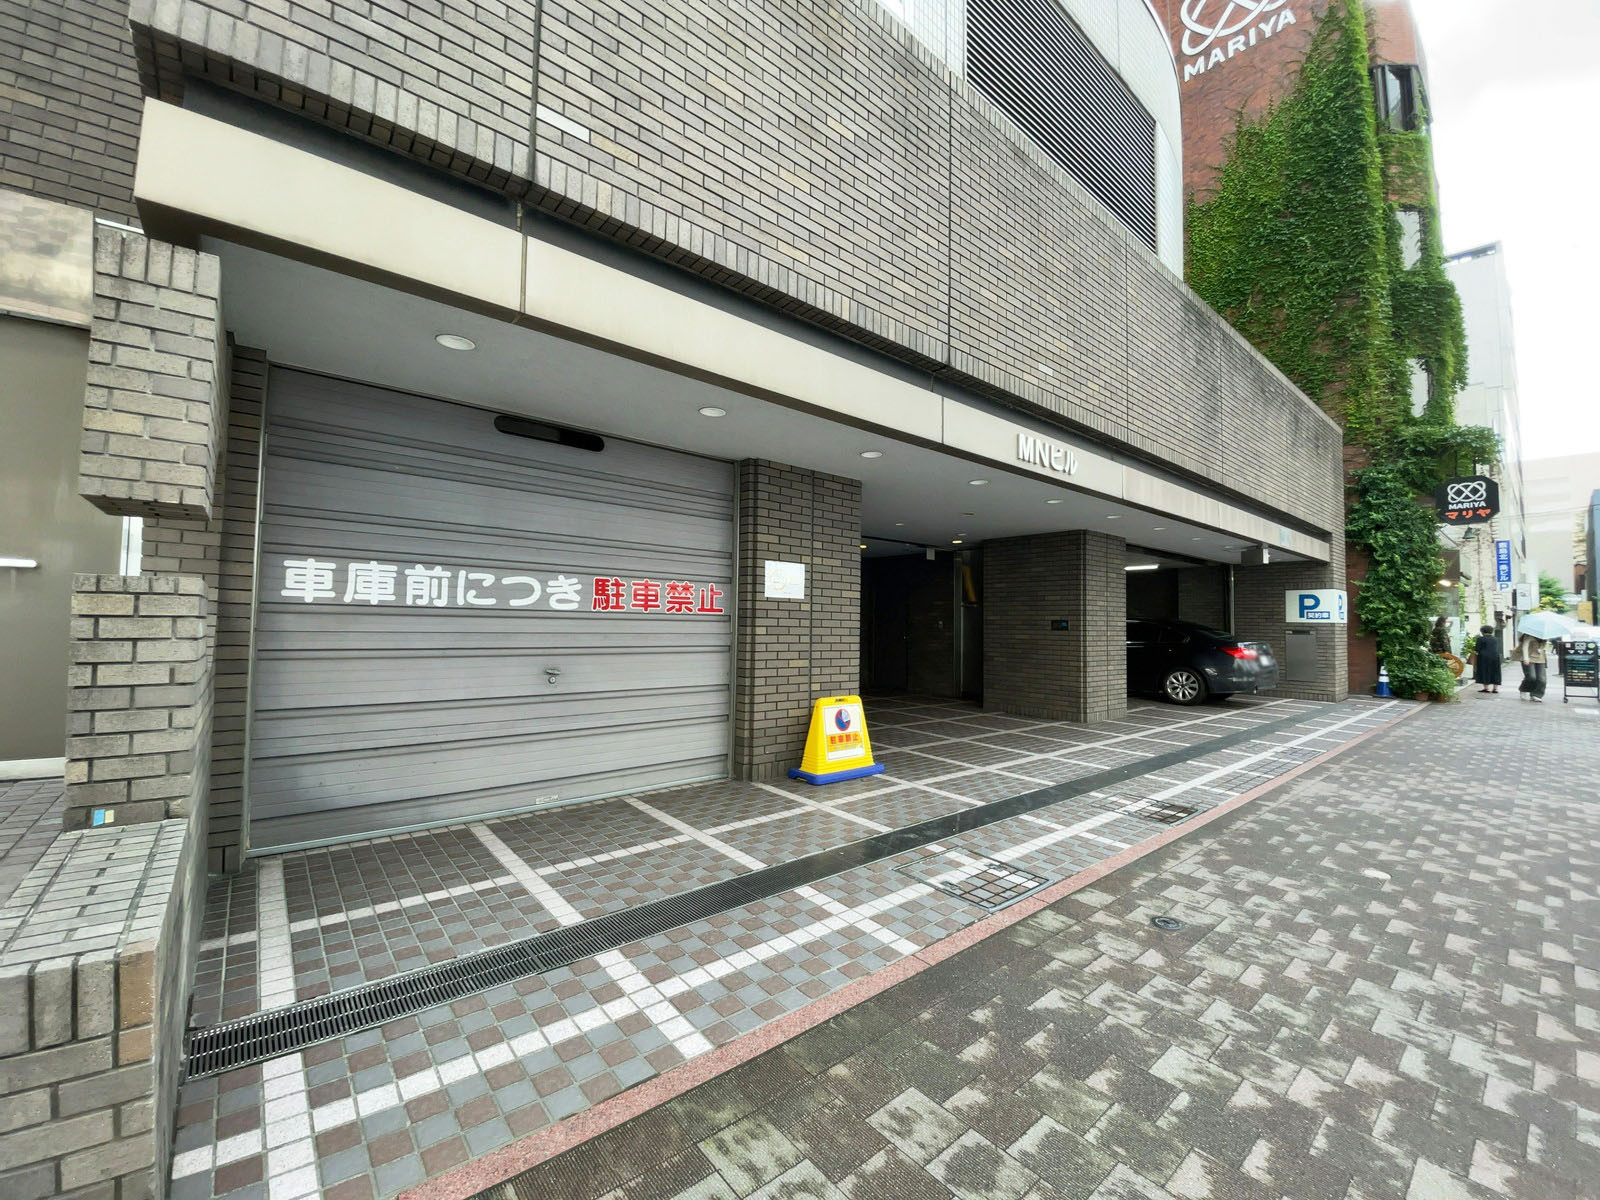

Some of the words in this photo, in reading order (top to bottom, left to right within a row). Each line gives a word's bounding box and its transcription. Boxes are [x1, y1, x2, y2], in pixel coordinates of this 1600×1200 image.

[1184, 9, 1296, 82] MARIYA
[1017, 433, 1078, 475] MNビル
[1445, 509, 1491, 519] マリヤ
[1448, 501, 1486, 510] MARIYA
[1299, 594, 1320, 618] P
